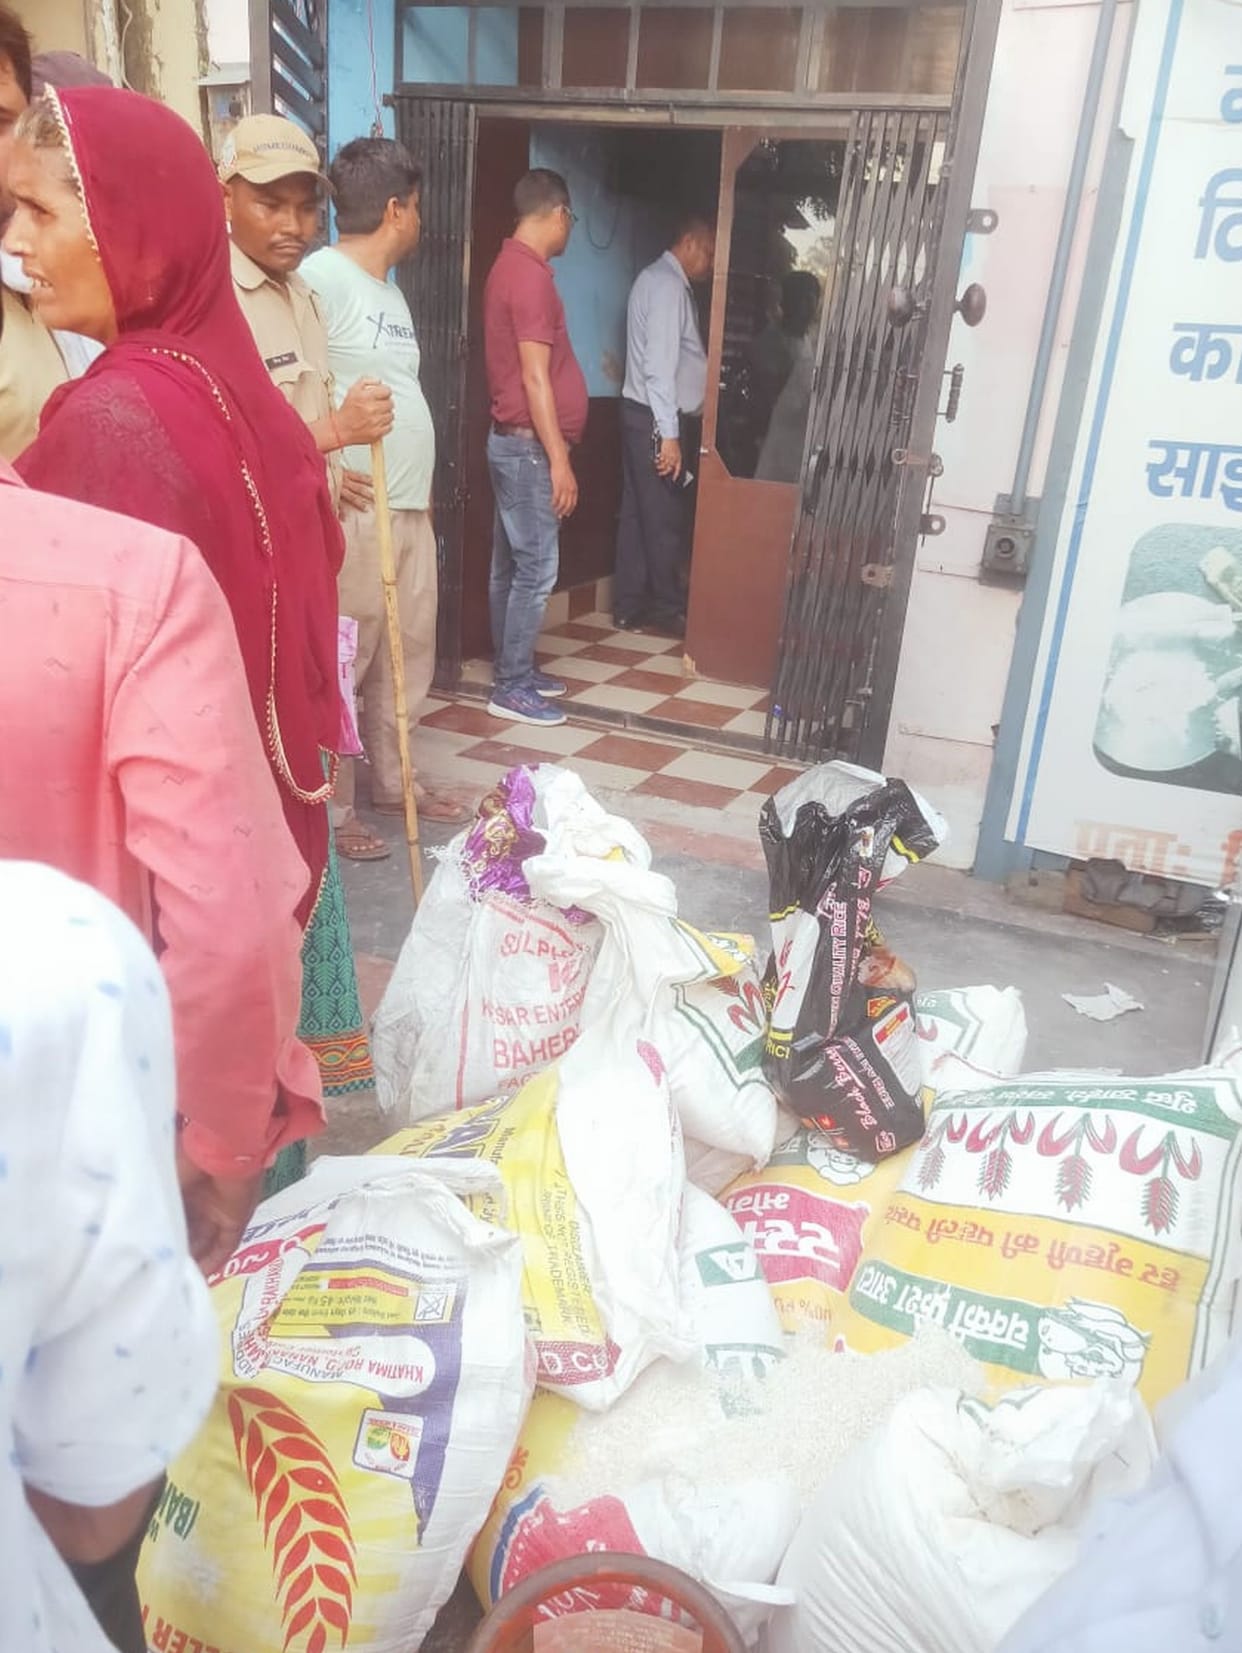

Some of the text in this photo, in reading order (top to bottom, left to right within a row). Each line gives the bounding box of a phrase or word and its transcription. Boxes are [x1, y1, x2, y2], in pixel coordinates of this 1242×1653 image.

[1001, 1232, 1040, 1260] की
[1138, 1262, 1181, 1291] हर
[367, 1358, 423, 1384] KHATIMA
